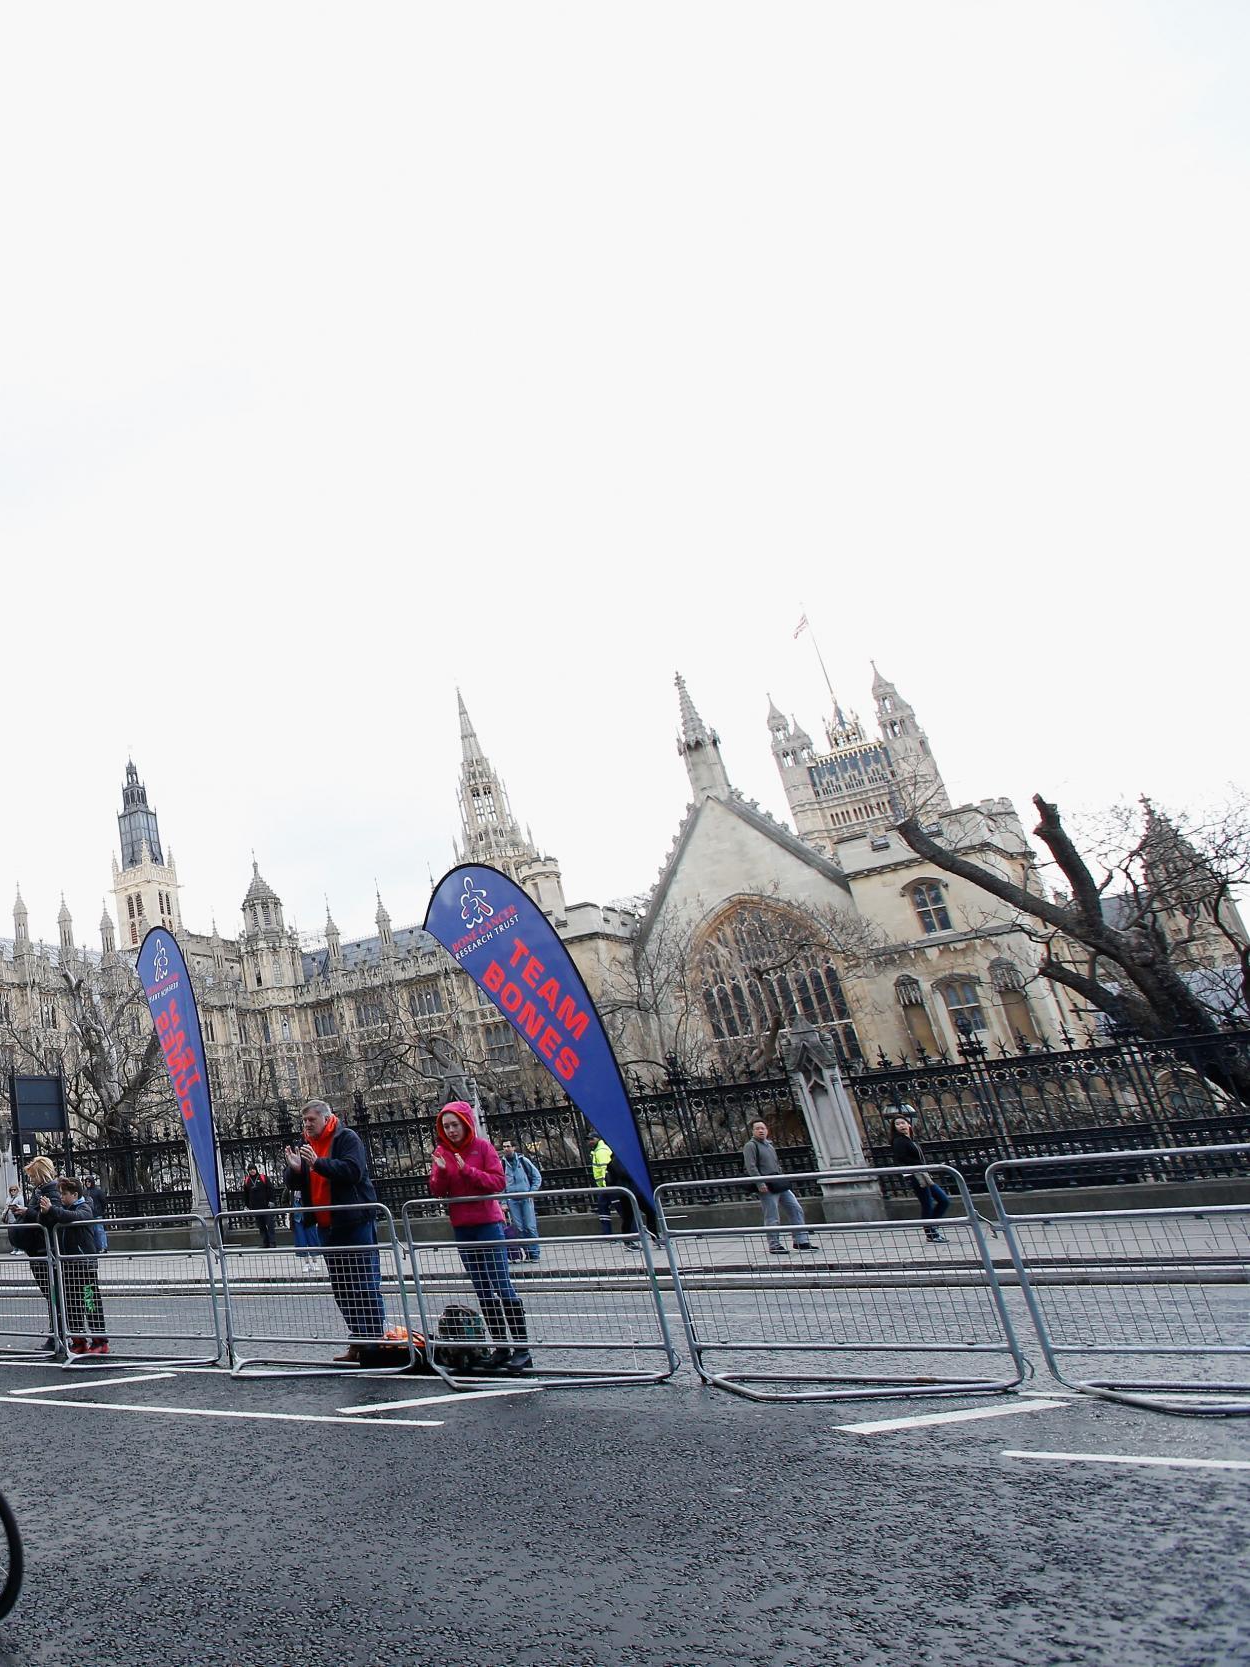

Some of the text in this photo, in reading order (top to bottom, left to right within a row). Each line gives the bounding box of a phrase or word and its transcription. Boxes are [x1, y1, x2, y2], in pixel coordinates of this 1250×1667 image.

[455, 914, 519, 961] RESEARCH TRUST
[482, 959, 580, 1081] BONES
[509, 938, 590, 1041] TEAM
